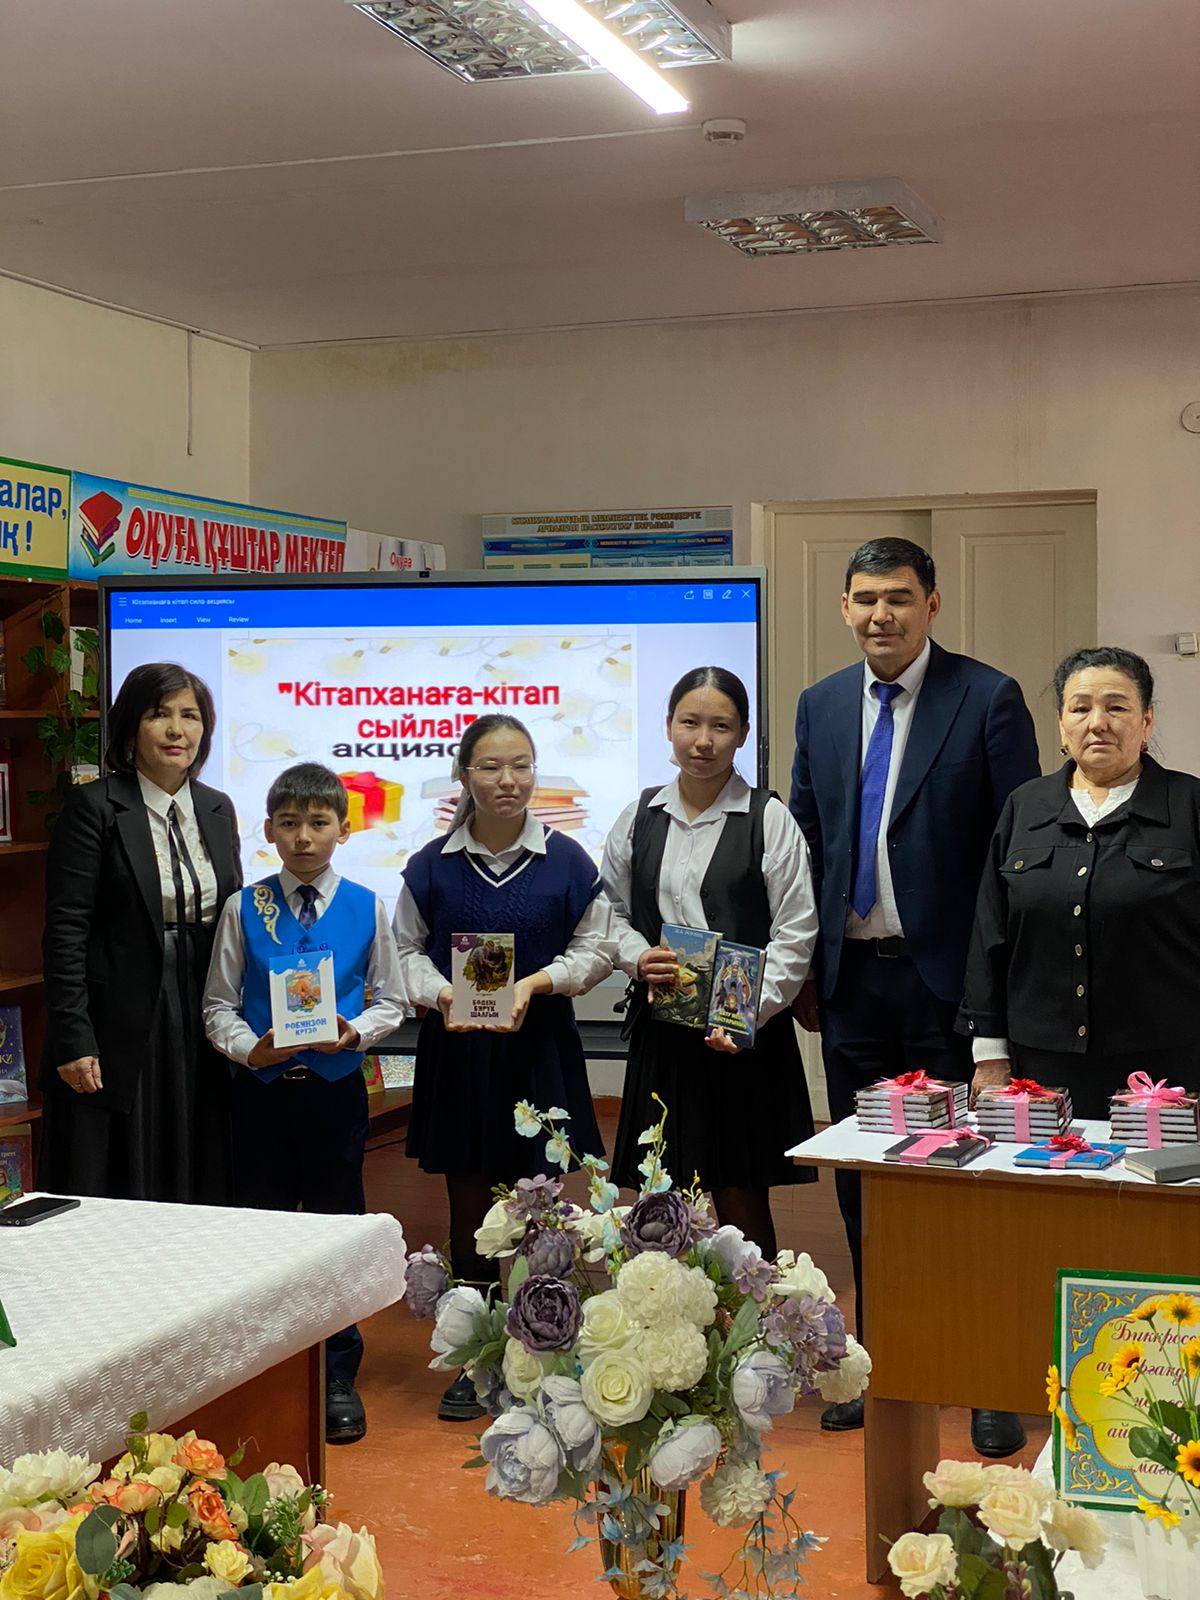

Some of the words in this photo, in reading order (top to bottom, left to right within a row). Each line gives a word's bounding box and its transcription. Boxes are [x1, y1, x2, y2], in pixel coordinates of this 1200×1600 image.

[125, 506, 201, 568] ОҚУҒА
[203, 519, 280, 574] ҚҰШТАР
[278, 682, 560, 706] "Кітапханаға-кітап
[332, 743, 461, 760] акцияс
[285, 1018, 327, 1030] РОБИНЗОН
[295, 1027, 318, 1036] КРУЗО
